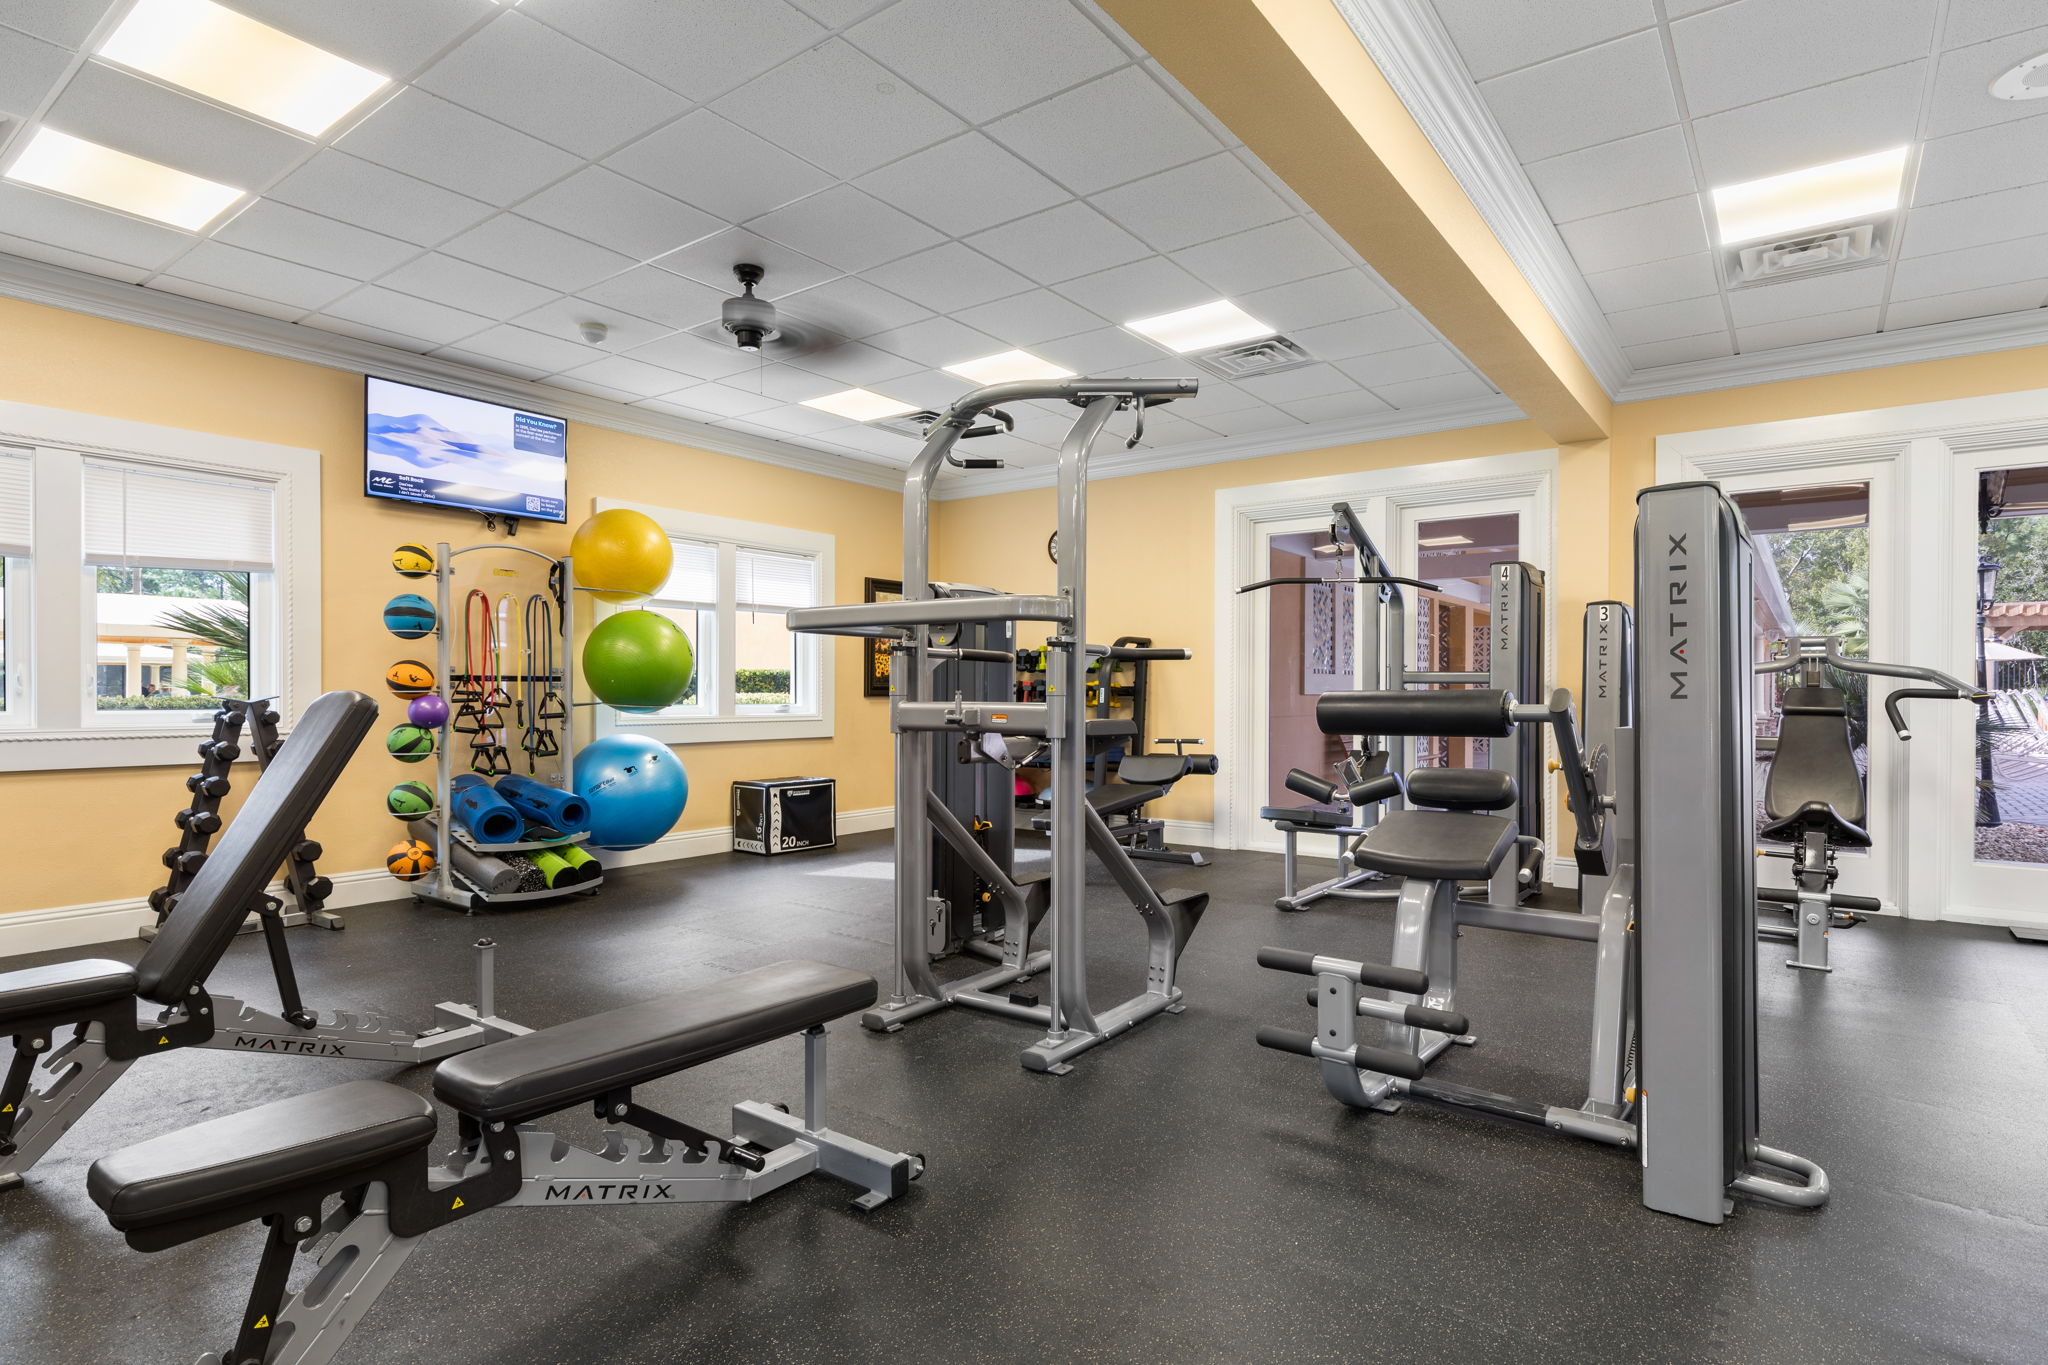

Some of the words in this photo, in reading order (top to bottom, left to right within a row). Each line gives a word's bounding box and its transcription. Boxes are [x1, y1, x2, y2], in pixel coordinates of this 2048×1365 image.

[526, 418, 538, 426] You
[538, 421, 557, 429] Know?
[1501, 567, 1510, 581] 4
[1501, 582, 1509, 650] MATRIX
[1600, 606, 1609, 621] 3
[1669, 533, 1688, 699] MATRIX
[1599, 624, 1608, 698] MATRIX
[782, 836, 796, 848] 20
[234, 1035, 348, 1056] MATRIX
[545, 1183, 673, 1201] MATRIX
